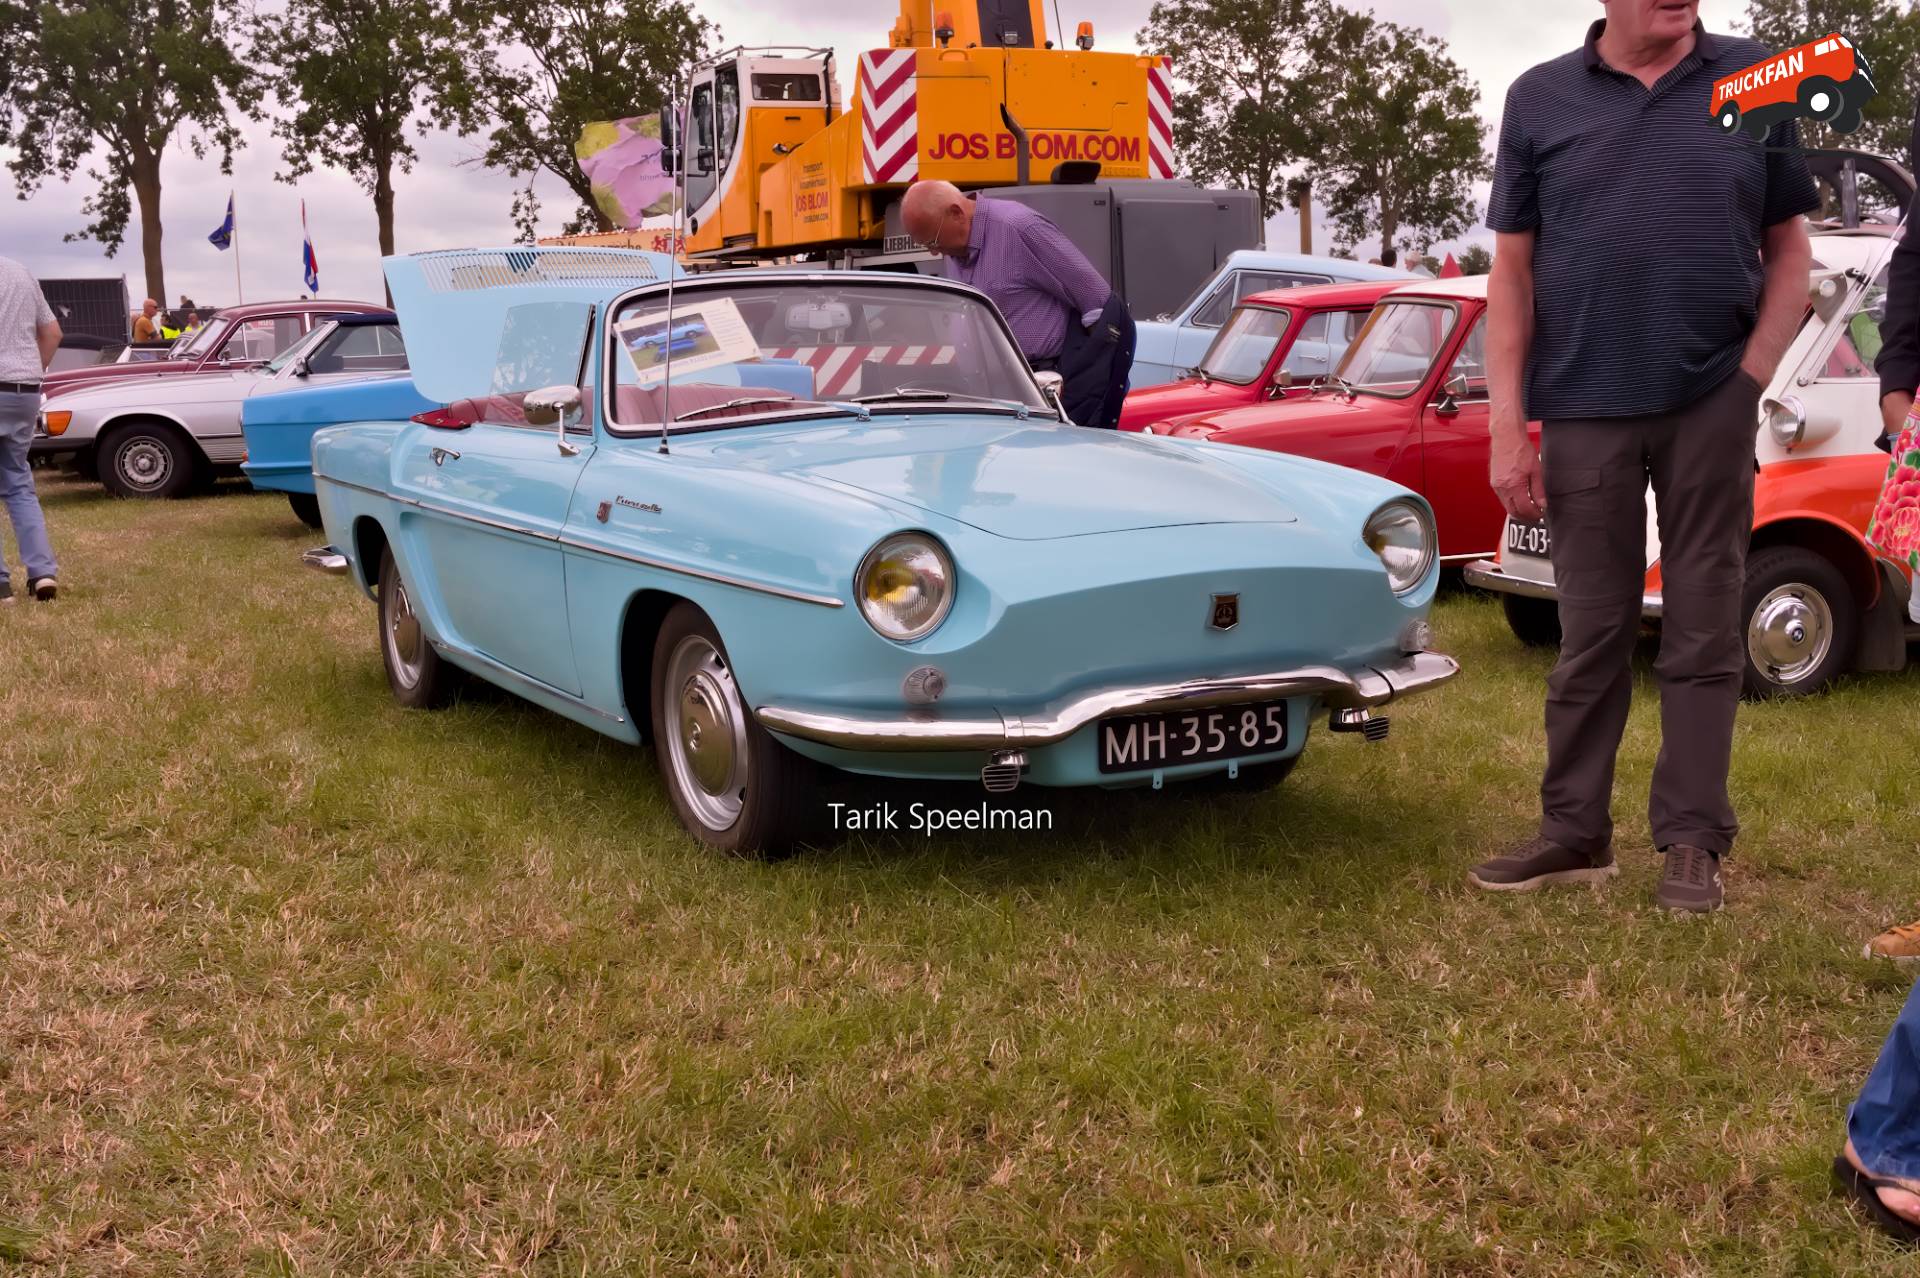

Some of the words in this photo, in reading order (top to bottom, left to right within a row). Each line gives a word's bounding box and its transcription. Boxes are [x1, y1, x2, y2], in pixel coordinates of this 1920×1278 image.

[928, 133, 989, 160] JOS
[996, 133, 1140, 162] BOM.COM
[794, 194, 807, 217] JOS
[808, 191, 828, 210] BLOM
[884, 235, 926, 253] LIEBH
[1509, 523, 1551, 553] DZ-03-
[1106, 706, 1283, 765] MH-35-85
